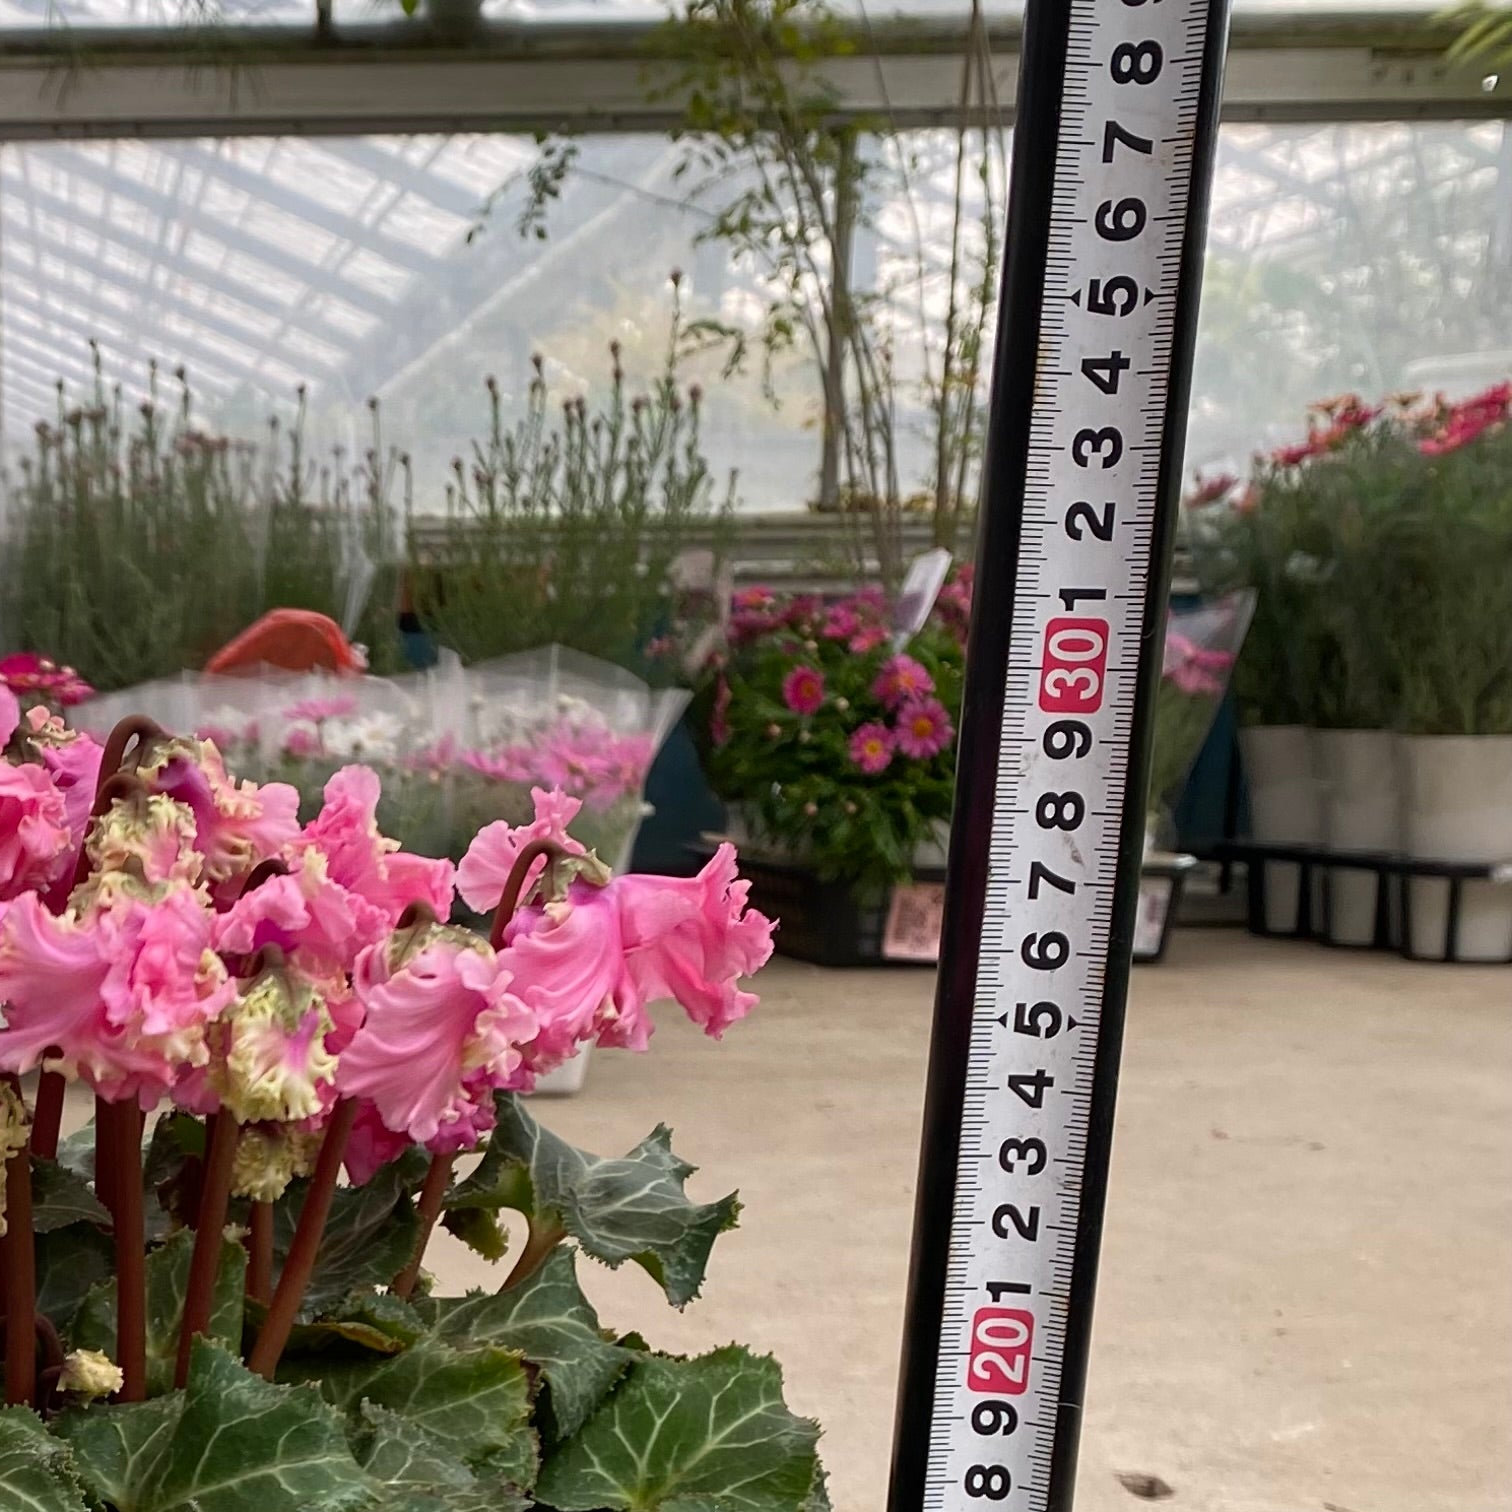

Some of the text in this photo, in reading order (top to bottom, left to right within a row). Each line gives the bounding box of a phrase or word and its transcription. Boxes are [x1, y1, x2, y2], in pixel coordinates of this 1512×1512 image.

[1109, 39, 1164, 86] 8
[1101, 120, 1154, 164] 7
[1094, 197, 1147, 242] 6
[1086, 275, 1139, 318] 5
[1080, 350, 1131, 395] 4
[1071, 426, 1123, 470] 3
[1064, 501, 1116, 542] 2
[1058, 588, 1107, 612] 1
[1044, 628, 1105, 700] 30
[1042, 719, 1093, 760] 9
[1035, 791, 1085, 832] 8
[1027, 861, 1076, 900] 7
[1020, 931, 1070, 971] 6
[1013, 1001, 1063, 1039] 5
[1007, 1068, 1055, 1109] 4
[998, 1137, 1047, 1176] 3
[991, 1203, 1041, 1242] 2
[985, 1281, 1032, 1303] 1
[972, 1316, 1030, 1384] 20
[971, 1399, 1018, 1436] 9
[964, 1464, 1012, 1501] 8
